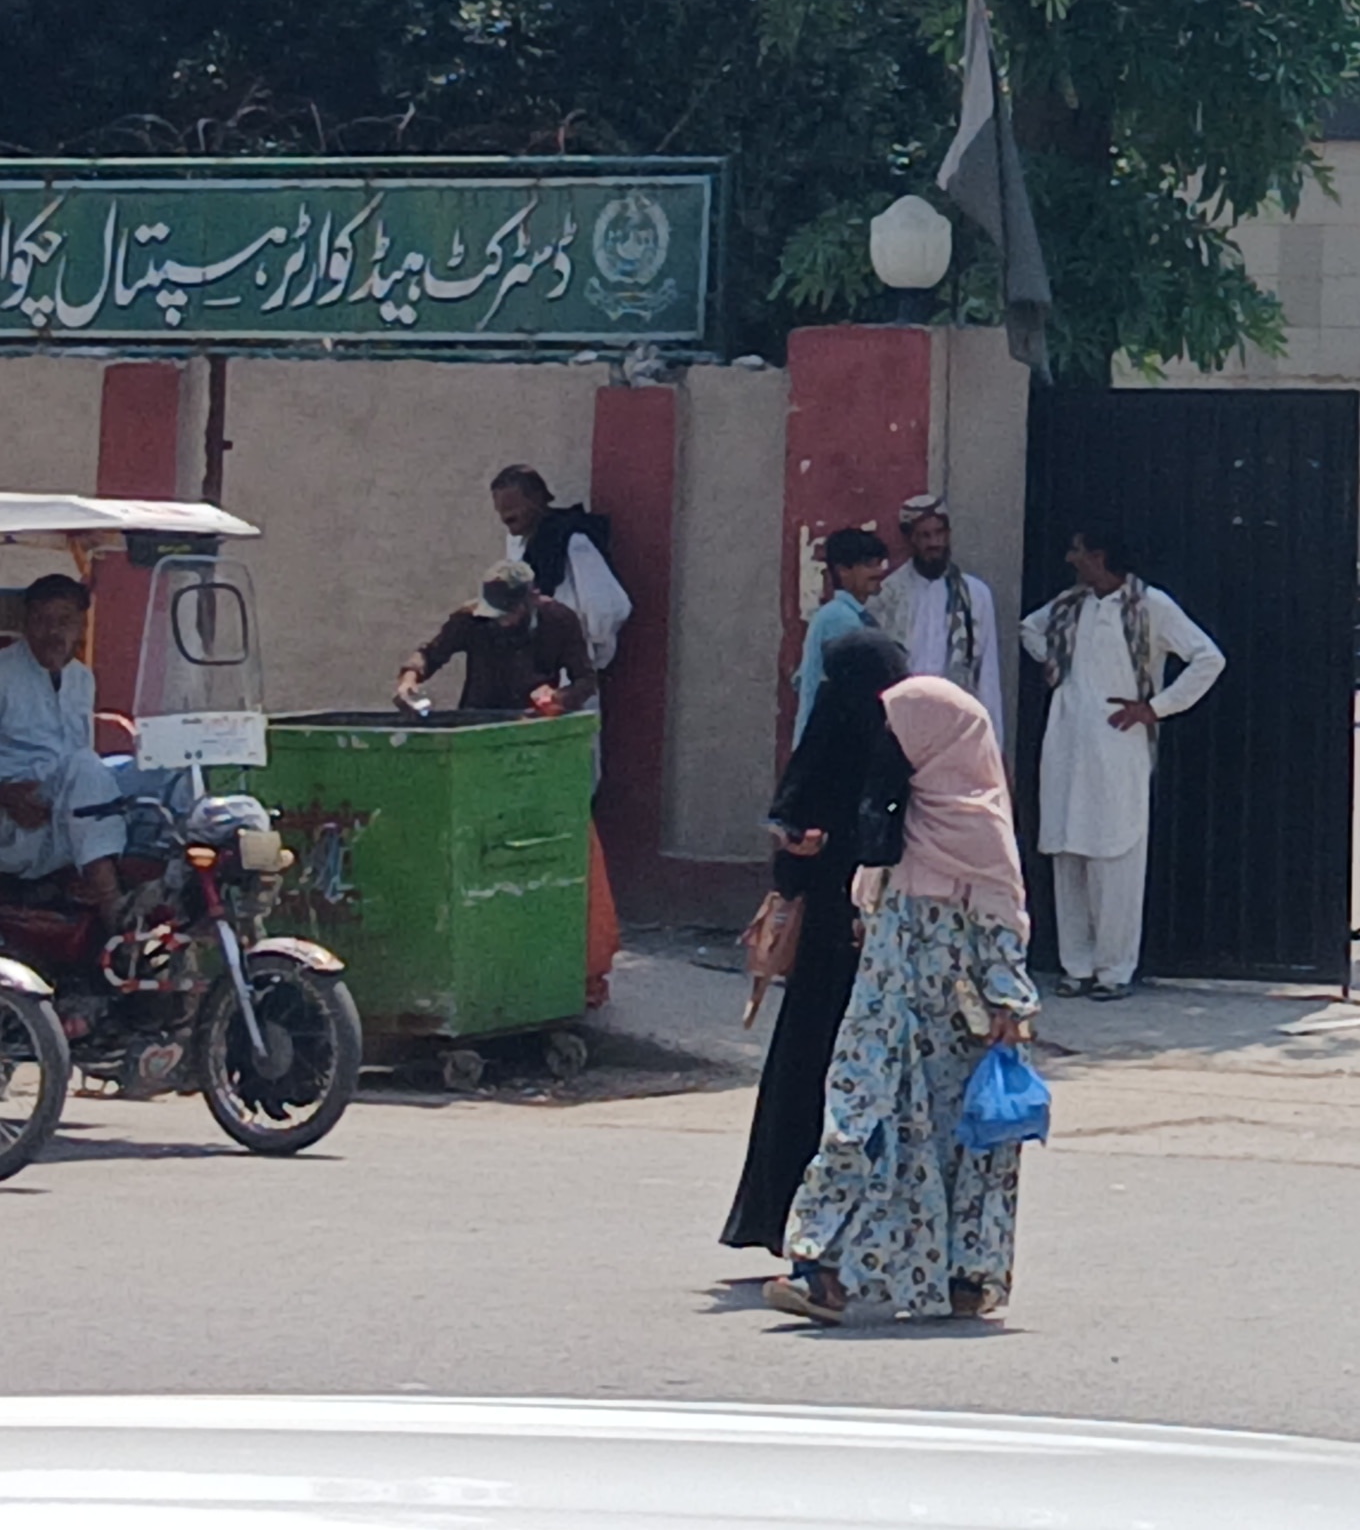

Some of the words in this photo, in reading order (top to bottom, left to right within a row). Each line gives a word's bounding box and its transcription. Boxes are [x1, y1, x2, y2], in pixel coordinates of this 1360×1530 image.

[0, 189, 68, 328] چکوا
[55, 198, 288, 328] ہسپتال
[423, 192, 578, 331] ڈسٹرکٹ
